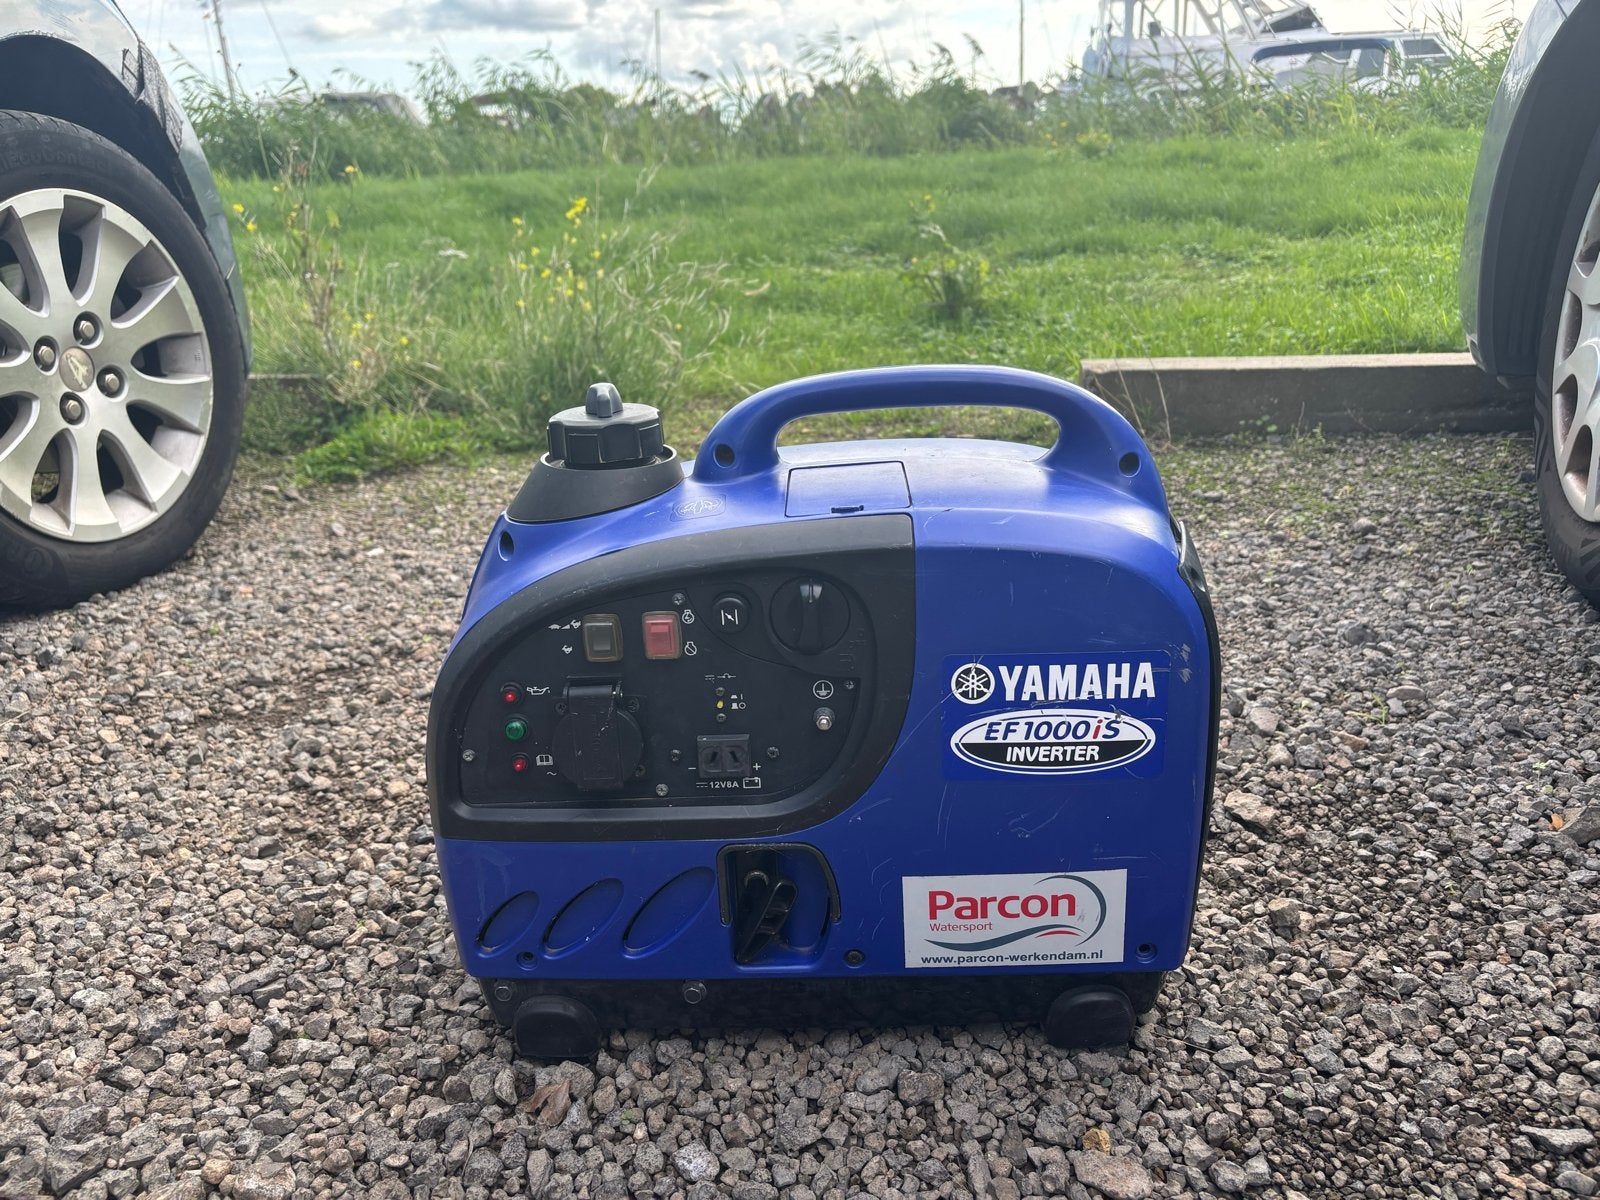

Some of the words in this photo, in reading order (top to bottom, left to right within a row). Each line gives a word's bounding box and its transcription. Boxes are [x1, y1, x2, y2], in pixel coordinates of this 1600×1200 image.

[998, 662, 1156, 701] YAMAHA
[984, 718, 1122, 741] EF1000iS
[1006, 745, 1100, 762] INVERTER
[709, 780, 739, 789] 12V8A
[928, 890, 1076, 921] Parcon
[929, 921, 993, 933] Watersport
[920, 949, 1103, 965] www.parcon-werkendam.nl
